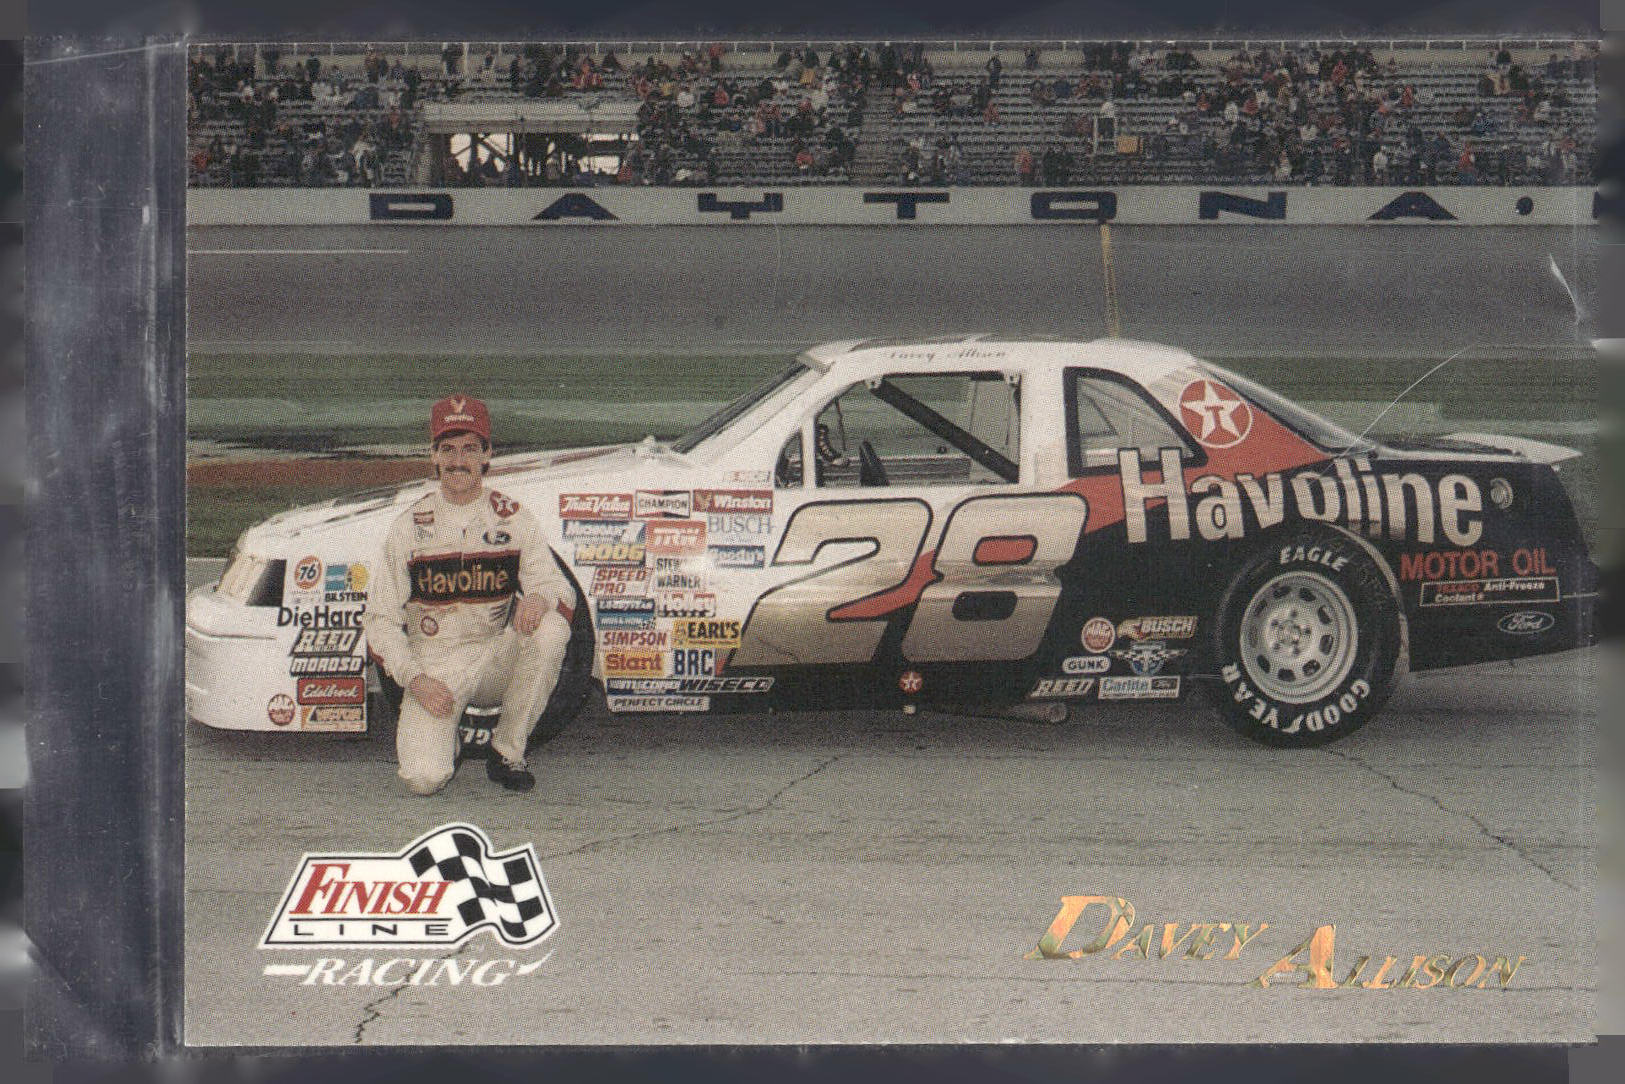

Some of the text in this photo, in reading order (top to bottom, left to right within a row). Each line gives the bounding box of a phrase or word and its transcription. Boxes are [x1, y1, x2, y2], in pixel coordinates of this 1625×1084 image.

[369, 191, 1459, 221] DAYTONA
[639, 499, 688, 510] CHAMPION
[714, 494, 771, 508] Winston
[1118, 448, 1483, 547] Havoline
[708, 516, 771, 534] BUSCH
[576, 543, 646, 561] MOOG
[1280, 546, 1348, 571] EAGLE
[299, 565, 317, 581] 76
[1401, 548, 1556, 581] MOTOR OIL
[418, 564, 508, 594] Havoline
[596, 570, 647, 582] SPEED
[731, 492, 1091, 667] 28
[594, 582, 626, 594] PRO
[325, 592, 368, 603] BILSTEIN
[687, 621, 739, 639] EARL'S
[1507, 613, 1543, 631] Ford
[294, 629, 358, 654] REED
[603, 631, 667, 646] SIMPSON
[605, 653, 663, 671] Stant
[674, 650, 714, 676] BRC
[1067, 660, 1104, 671] GUNK
[680, 679, 771, 692] WISECO
[1033, 679, 1093, 696] REED
[613, 698, 703, 707] PERFECT CIRCLE
[289, 863, 455, 915] FINISH
[293, 923, 449, 937] LINE
[1021, 895, 1527, 989] DAVEY ALLISON
[299, 957, 516, 987] RACING
